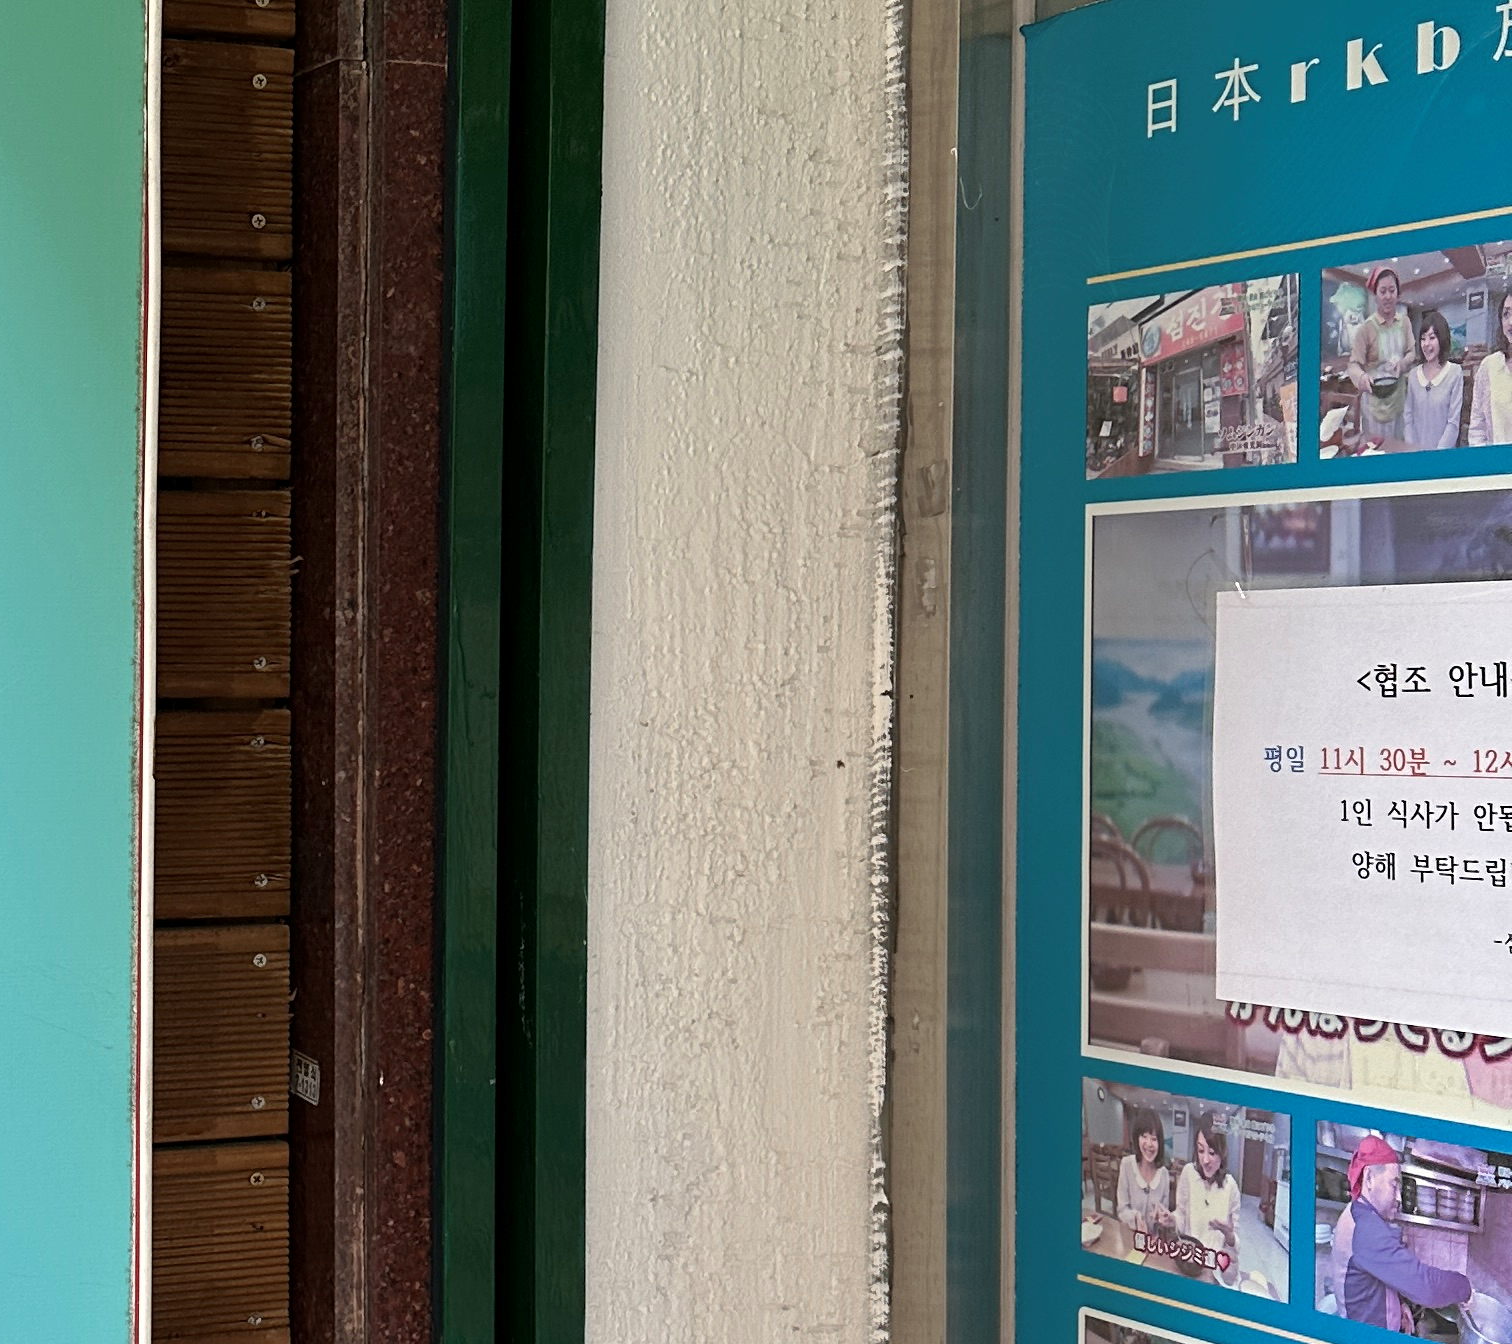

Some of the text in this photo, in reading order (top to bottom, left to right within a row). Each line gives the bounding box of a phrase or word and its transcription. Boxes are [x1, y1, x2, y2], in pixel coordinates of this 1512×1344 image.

[1357, 662, 1432, 698] <협조
[1264, 745, 1305, 773] 평일
[1321, 747, 1364, 775] 11시
[1380, 748, 1430, 776] 30분
[1340, 799, 1373, 827] 1인
[1388, 800, 1460, 831] 식사가
[1352, 851, 1397, 880] 양해
